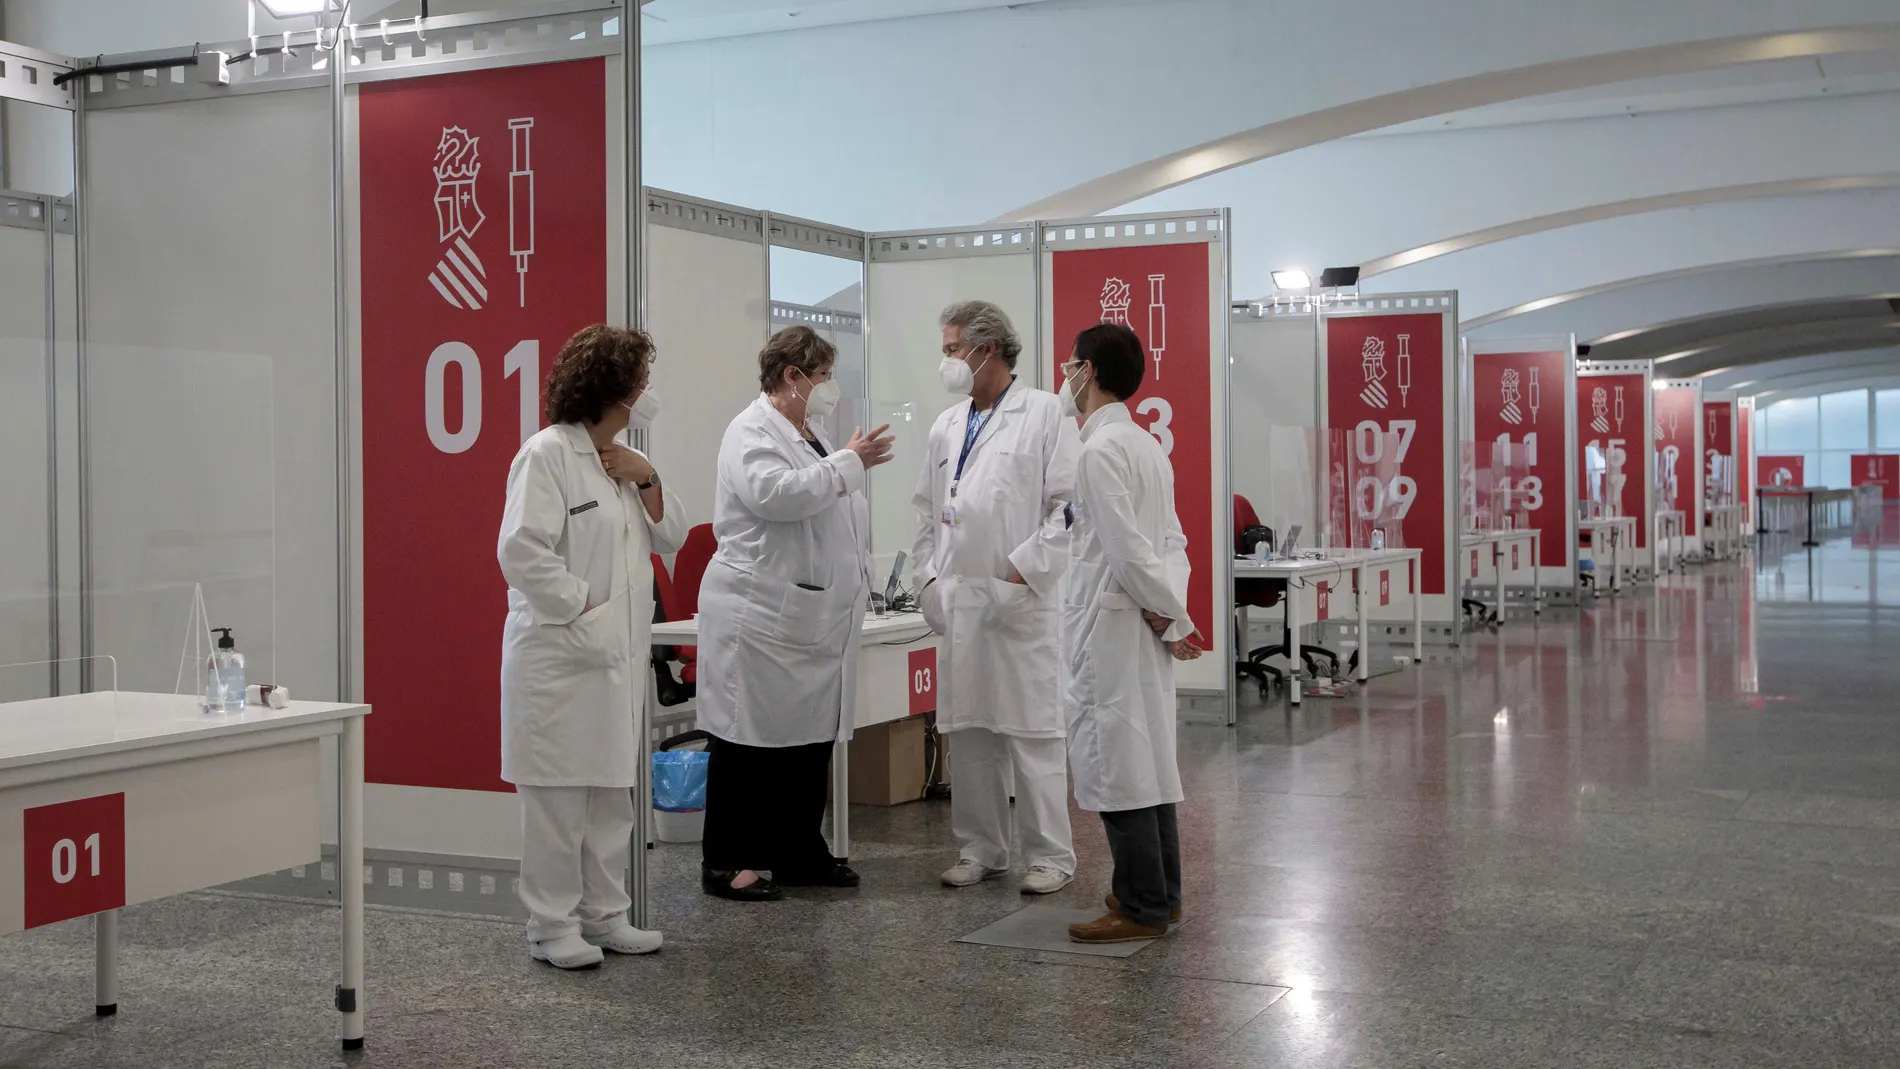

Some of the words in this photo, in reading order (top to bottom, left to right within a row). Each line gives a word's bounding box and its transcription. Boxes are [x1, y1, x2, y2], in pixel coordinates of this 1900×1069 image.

[425, 340, 540, 454] 01
[1136, 397, 1175, 457] 3
[1355, 420, 1417, 464] 07
[1497, 433, 1537, 466] 11
[1355, 476, 1418, 520] 09
[1499, 477, 1543, 510] 13
[915, 667, 931, 694] 03
[51, 832, 101, 884] 01
